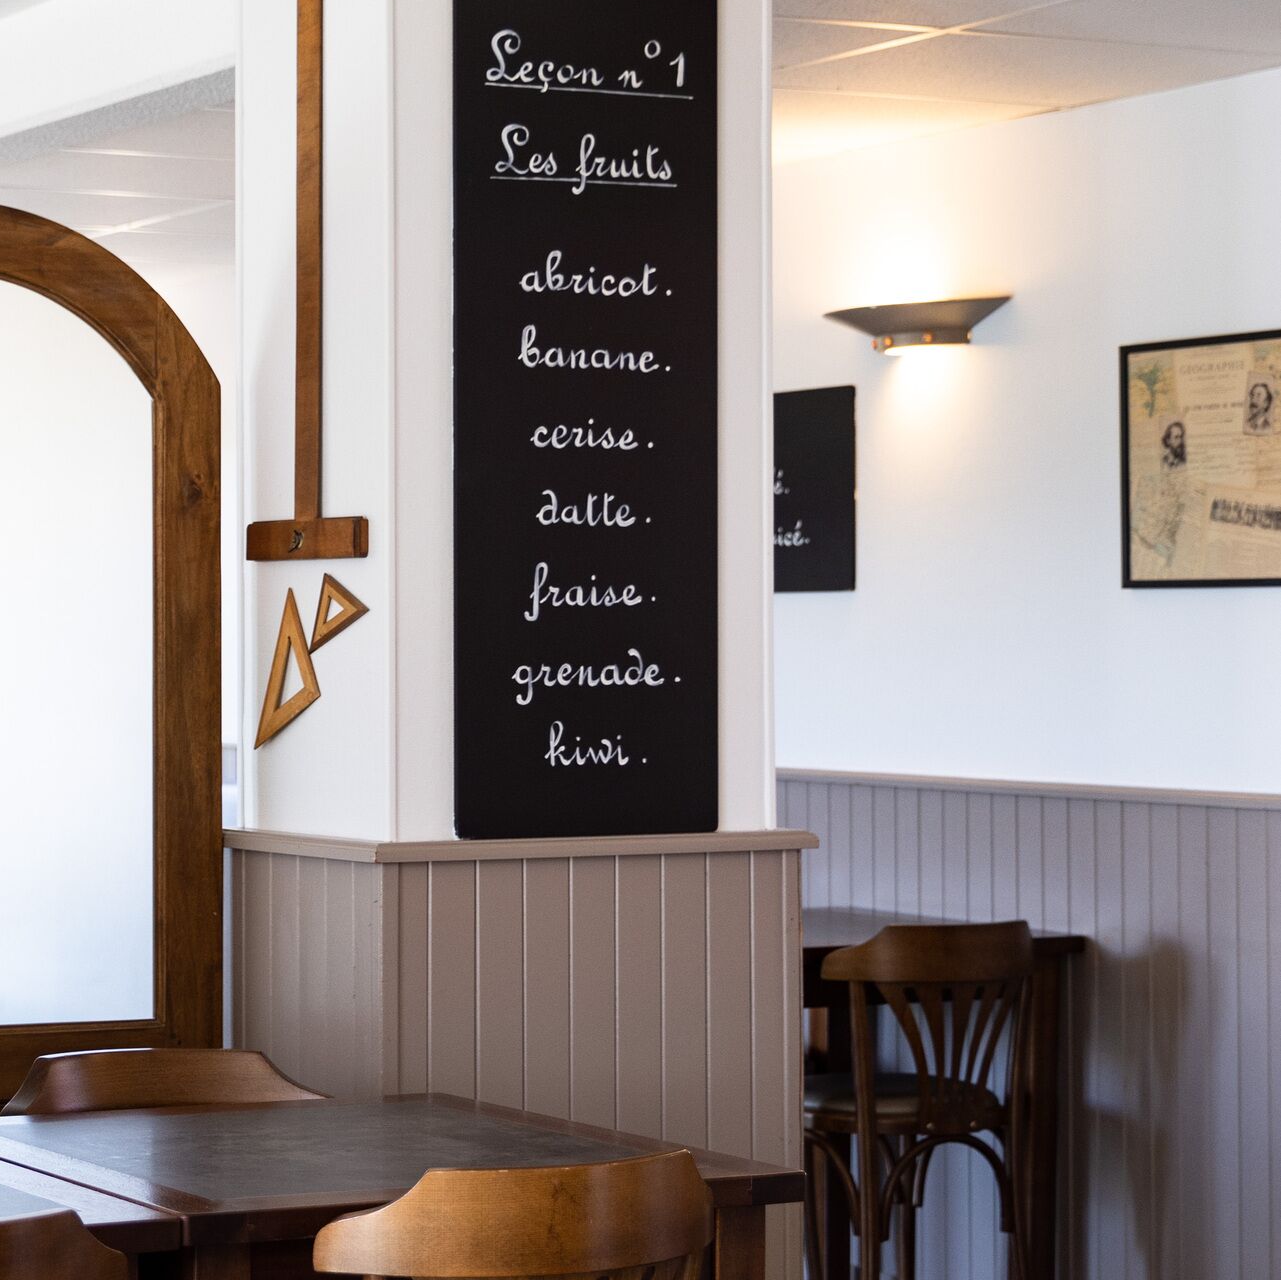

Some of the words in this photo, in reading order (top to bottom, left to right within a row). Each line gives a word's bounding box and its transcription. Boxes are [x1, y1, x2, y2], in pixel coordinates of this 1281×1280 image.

[485, 30, 606, 93] Leçon
[494, 123, 558, 176] Les
[571, 133, 673, 195] fruits
